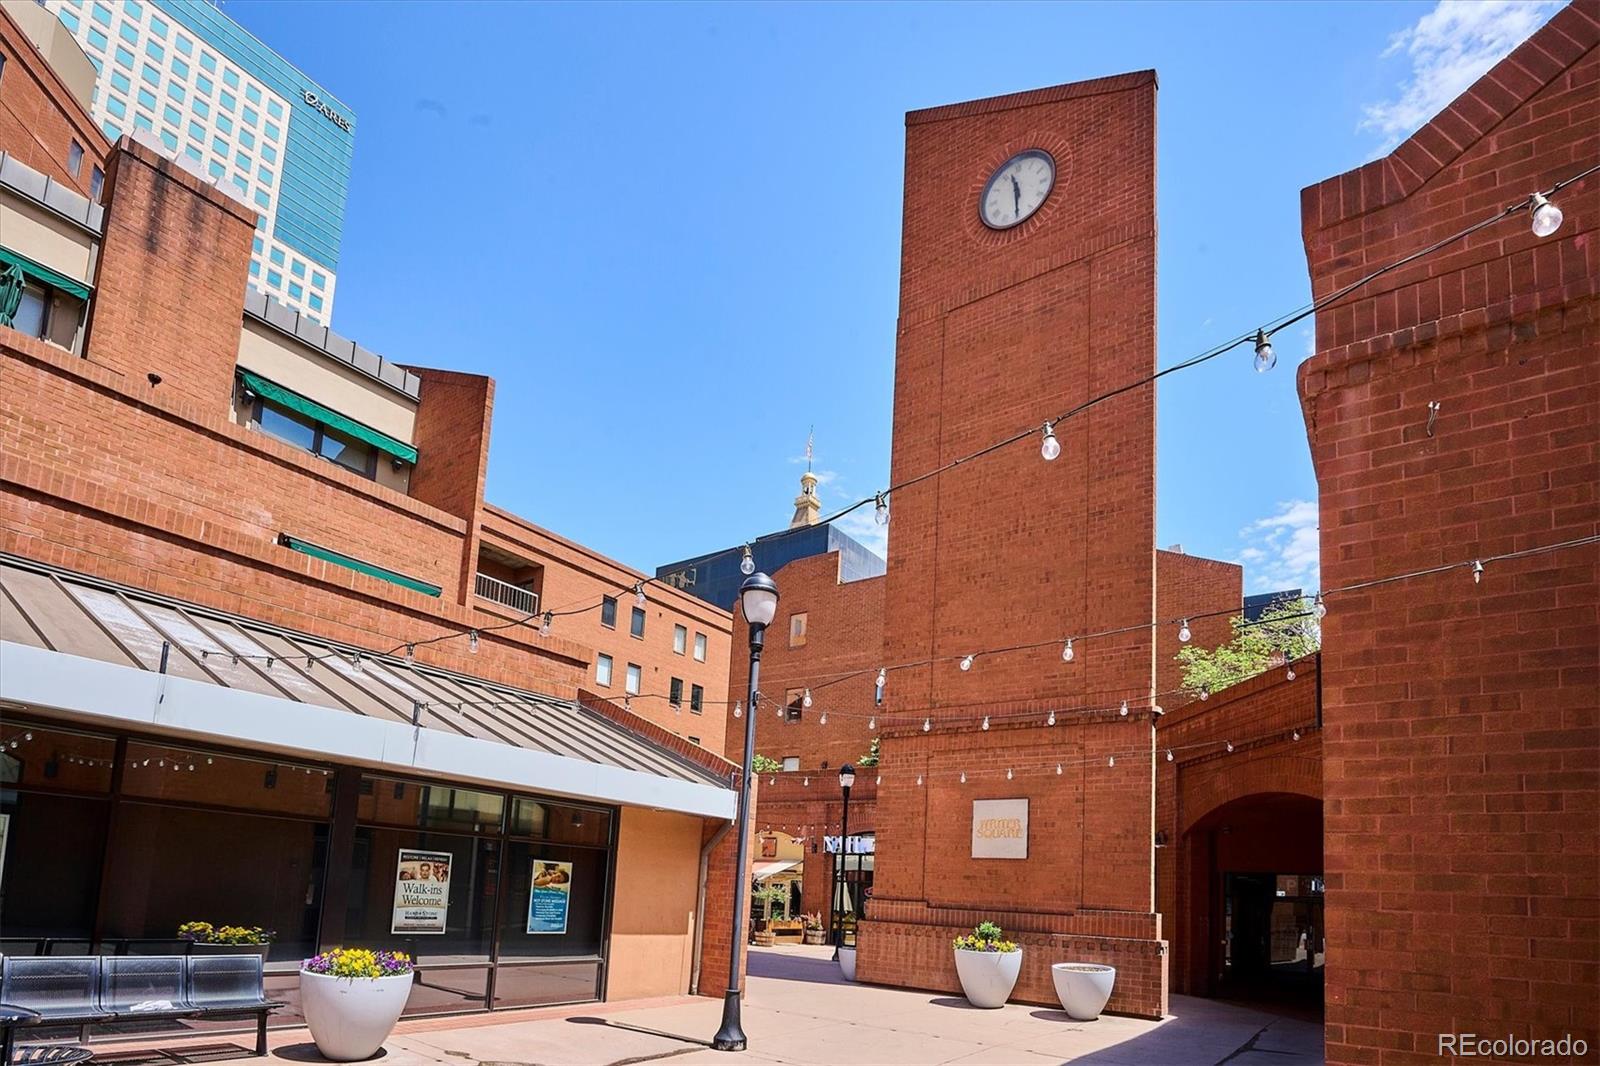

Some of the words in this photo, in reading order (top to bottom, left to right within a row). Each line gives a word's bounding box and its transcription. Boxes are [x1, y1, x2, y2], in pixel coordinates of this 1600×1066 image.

[318, 103, 352, 132] ARES
[976, 829, 1024, 839] SQUARE
[402, 882, 443, 895] Walk-ins
[402, 894, 442, 906] Welcome
